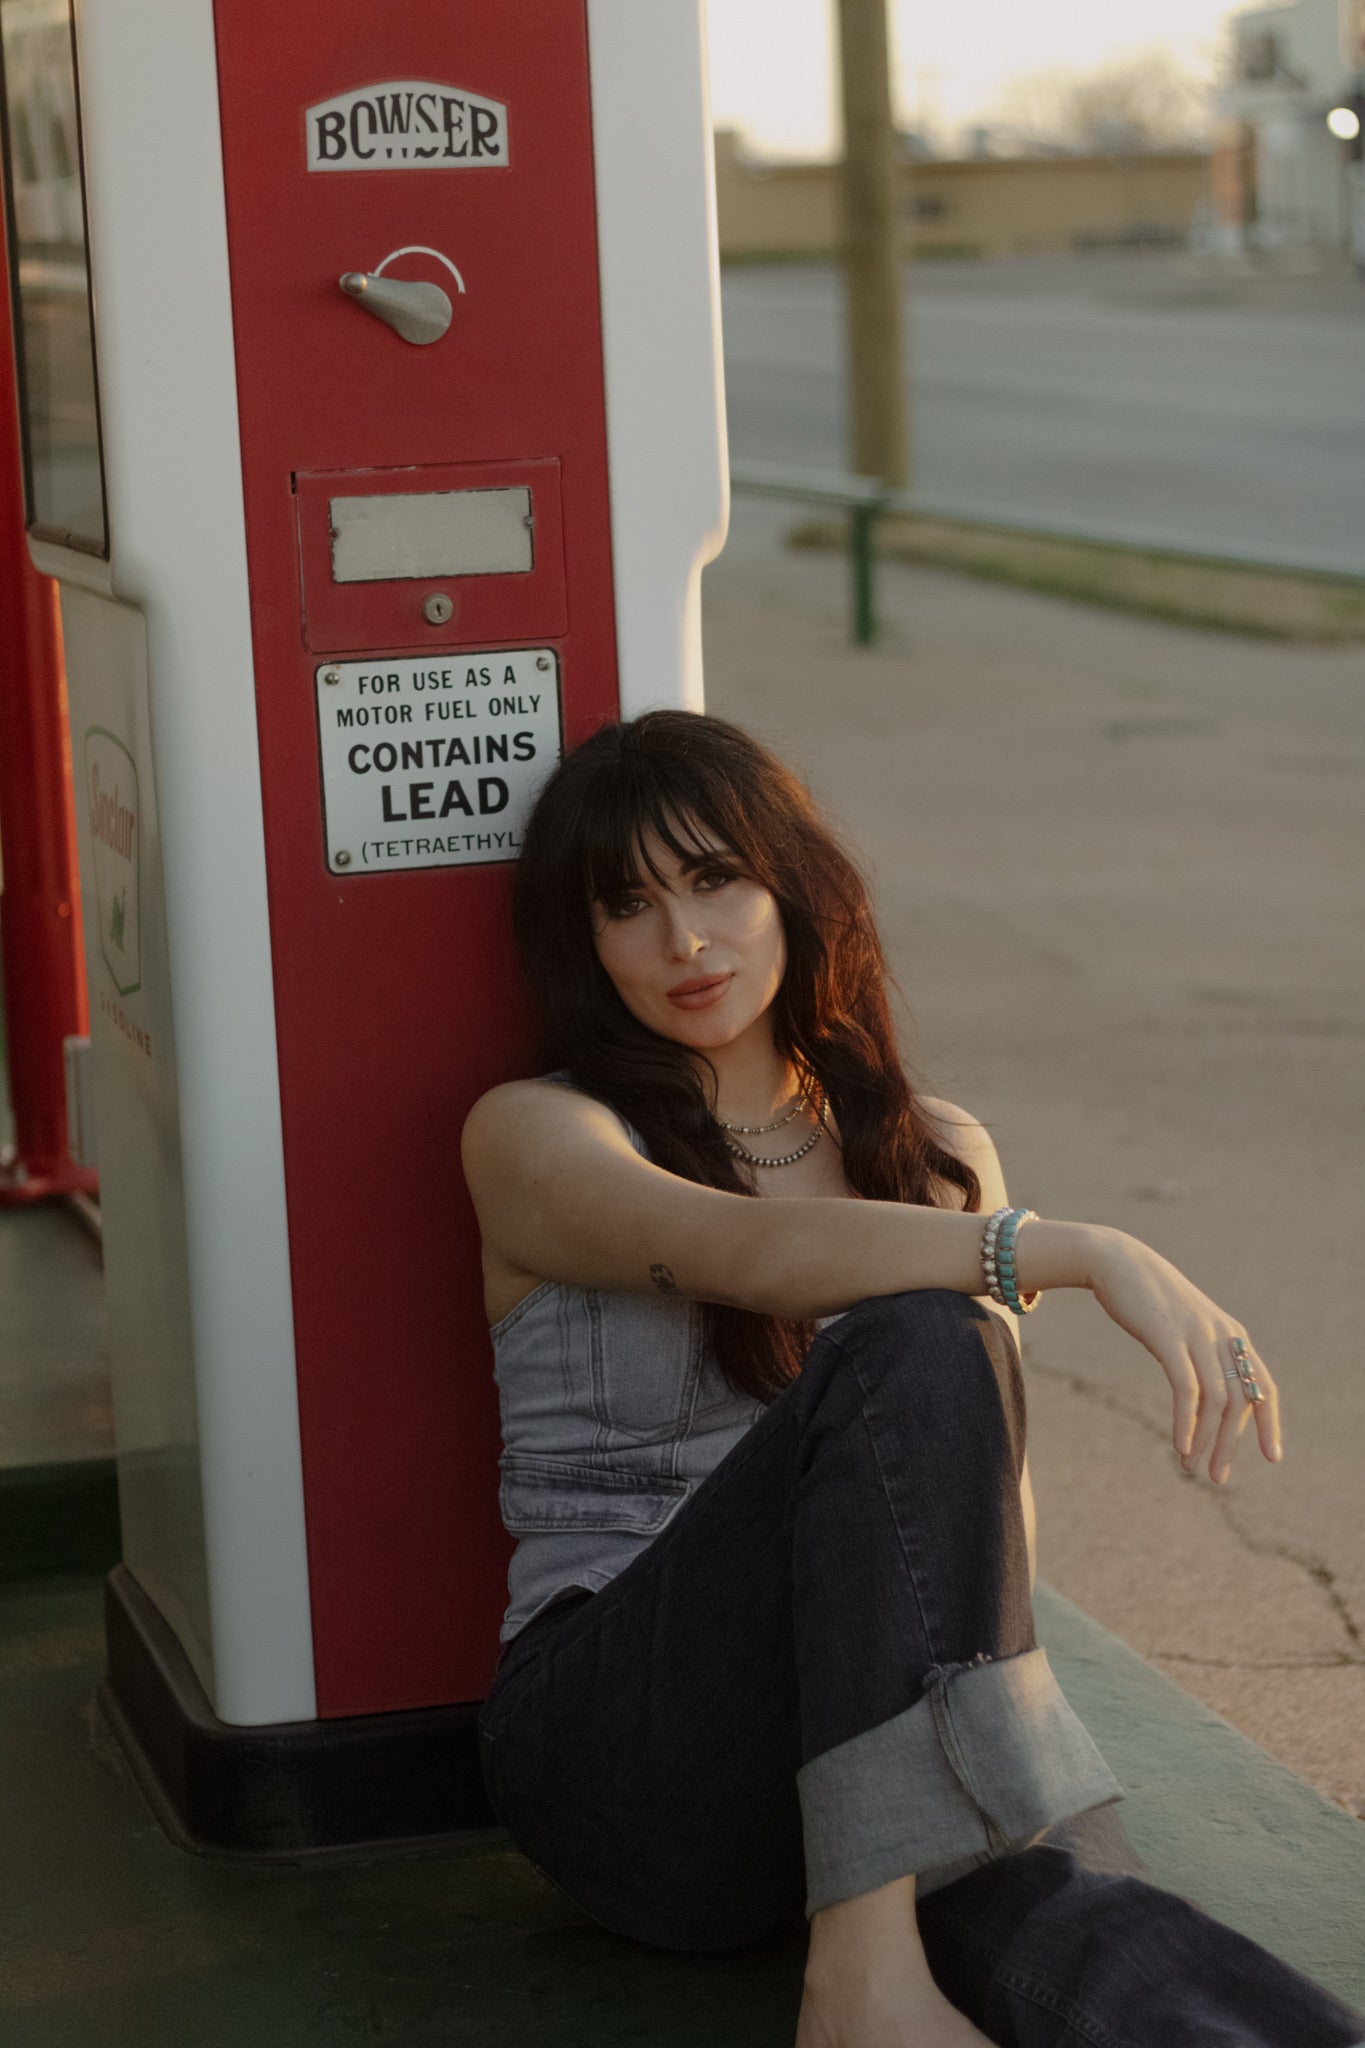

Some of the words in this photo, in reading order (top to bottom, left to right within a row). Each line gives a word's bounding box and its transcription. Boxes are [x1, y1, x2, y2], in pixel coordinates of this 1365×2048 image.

[315, 92, 500, 161] BOWSER
[358, 674, 401, 695] FOR
[412, 670, 453, 691] USE
[465, 667, 492, 688] AS
[503, 665, 517, 685] A
[336, 704, 413, 728] MOTOR
[425, 700, 477, 721] FUEL
[488, 694, 541, 717] ONLY
[348, 731, 537, 775] CONTAINS
[381, 776, 510, 823] LEAD
[361, 831, 521, 864] (TETRAETHYL
